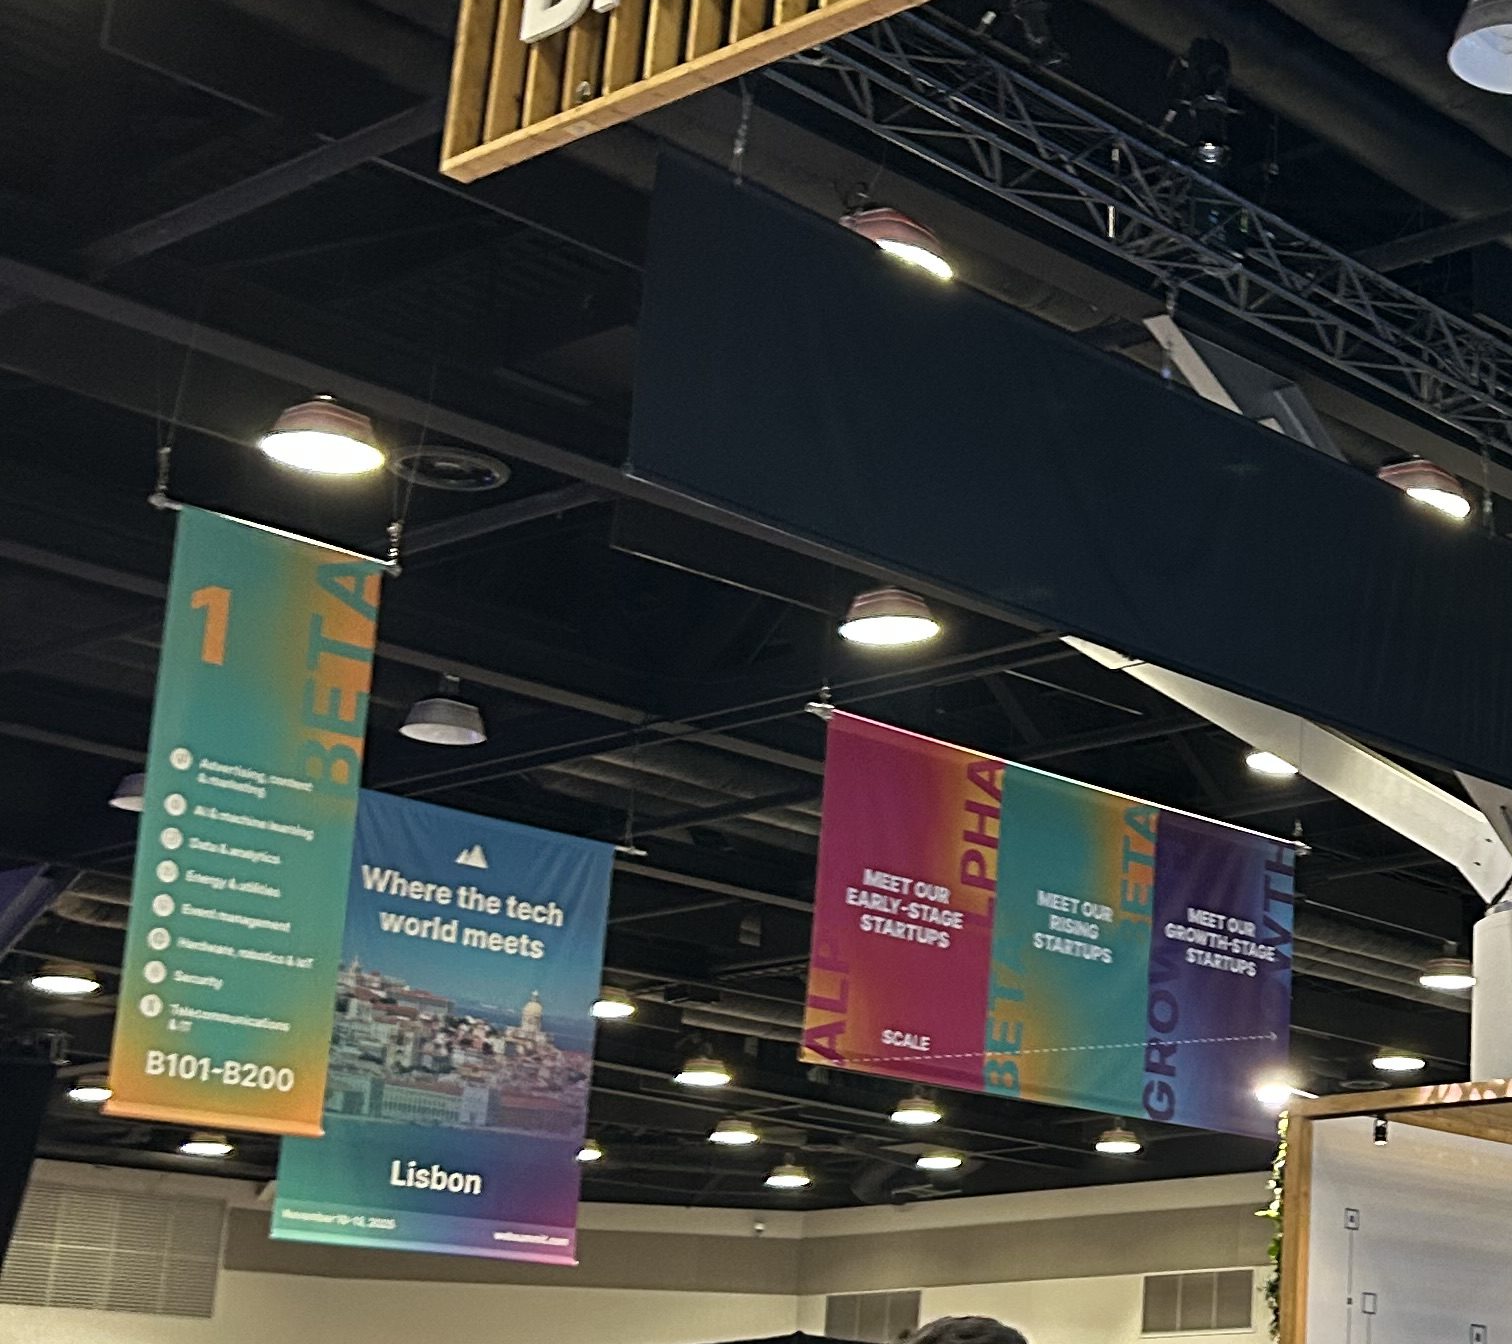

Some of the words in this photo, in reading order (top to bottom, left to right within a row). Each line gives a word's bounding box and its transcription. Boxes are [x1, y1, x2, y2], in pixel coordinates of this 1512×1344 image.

[190, 585, 233, 666] 1
[302, 559, 384, 794] BETA
[361, 864, 452, 906] Where
[456, 886, 502, 915] the
[506, 895, 565, 928] tech
[863, 868, 913, 895] MEET
[914, 881, 951, 904] OUR
[845, 887, 964, 929] EARLY-STAGE
[1037, 890, 1080, 914] MEET
[1081, 901, 1113, 923] OUR
[1187, 907, 1226, 930] MEET
[1226, 917, 1256, 938] OUR
[379, 911, 459, 944] world
[462, 926, 545, 960] meets
[860, 914, 951, 948] STARTUPS
[1048, 914, 1099, 940] RISING
[1164, 923, 1276, 963] GROWTH-STAGE
[1032, 932, 1113, 964] STARTUPS
[1185, 947, 1257, 977] STARTUPS
[881, 1029, 931, 1052] SCALE
[145, 1050, 295, 1093] B101-B200
[390, 1160, 482, 1195] Lisbon
